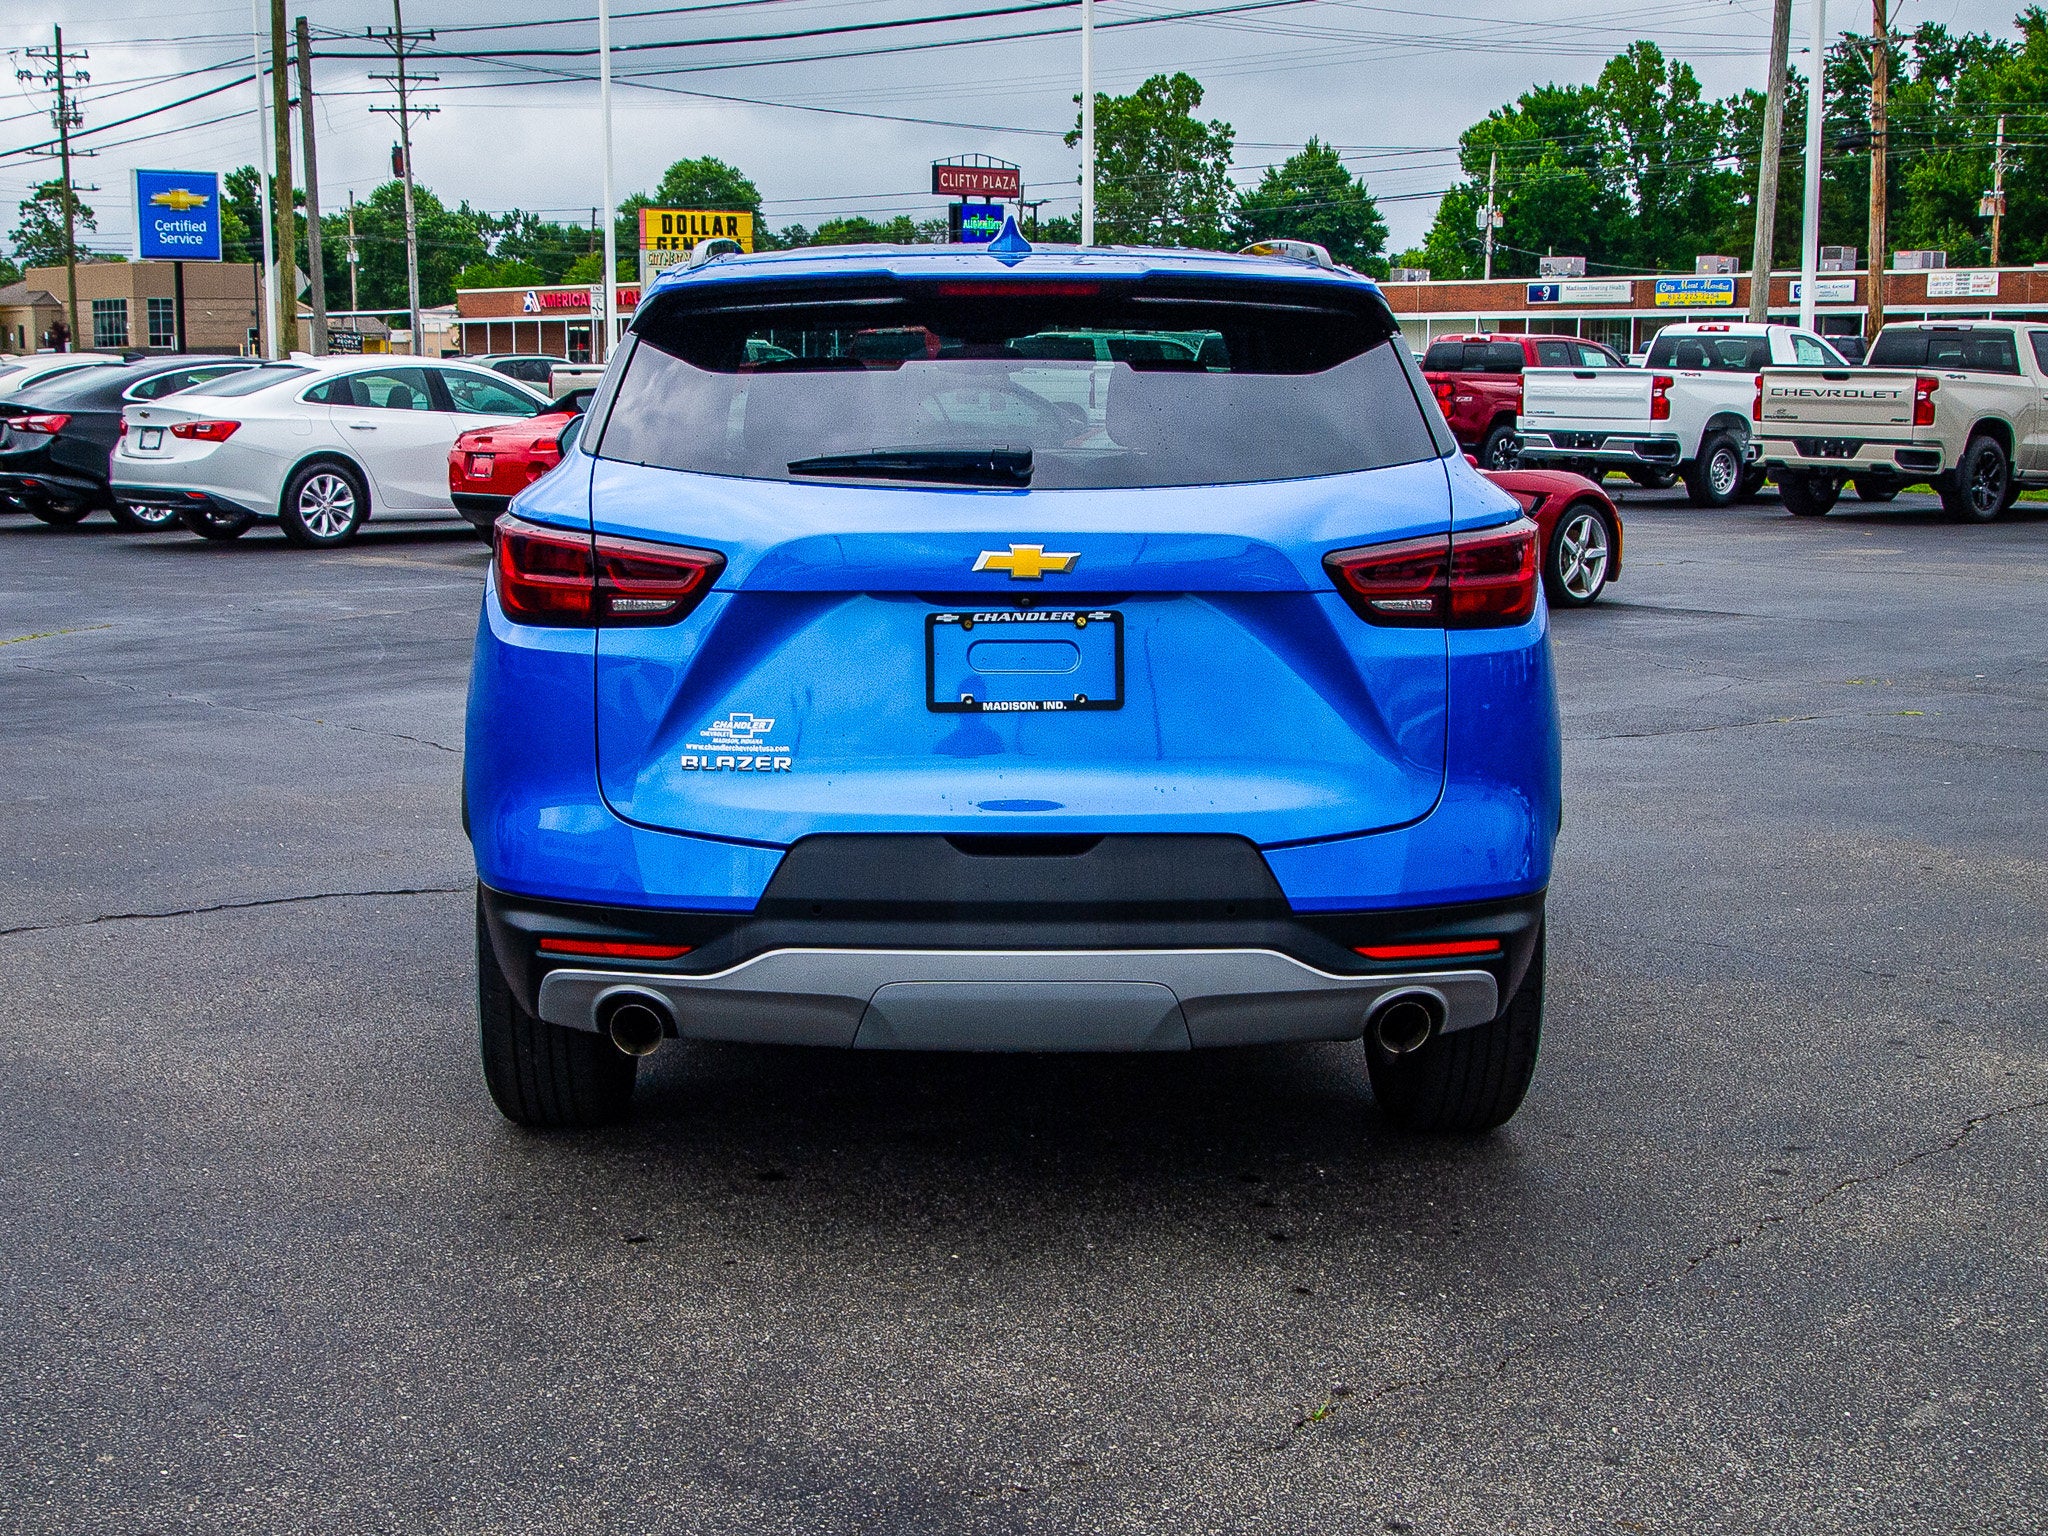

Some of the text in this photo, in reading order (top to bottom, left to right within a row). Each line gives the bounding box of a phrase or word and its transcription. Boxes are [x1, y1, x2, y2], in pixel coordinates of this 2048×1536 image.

[940, 173, 1017, 190] CLIFTY PLAZA
[154, 220, 207, 232] Certified
[661, 214, 739, 236] DOLLAR
[159, 232, 203, 244] Service
[1531, 385, 1643, 397] CHEVROLET
[1771, 388, 1902, 399] CHEVROLET
[972, 611, 1076, 622] CHANDLER
[1043, 701, 1067, 710] IND.
[712, 720, 767, 730] CHANDLER
[685, 743, 790, 752] www.chandlerchevroletusa.com
[681, 755, 792, 773] BLAZER
